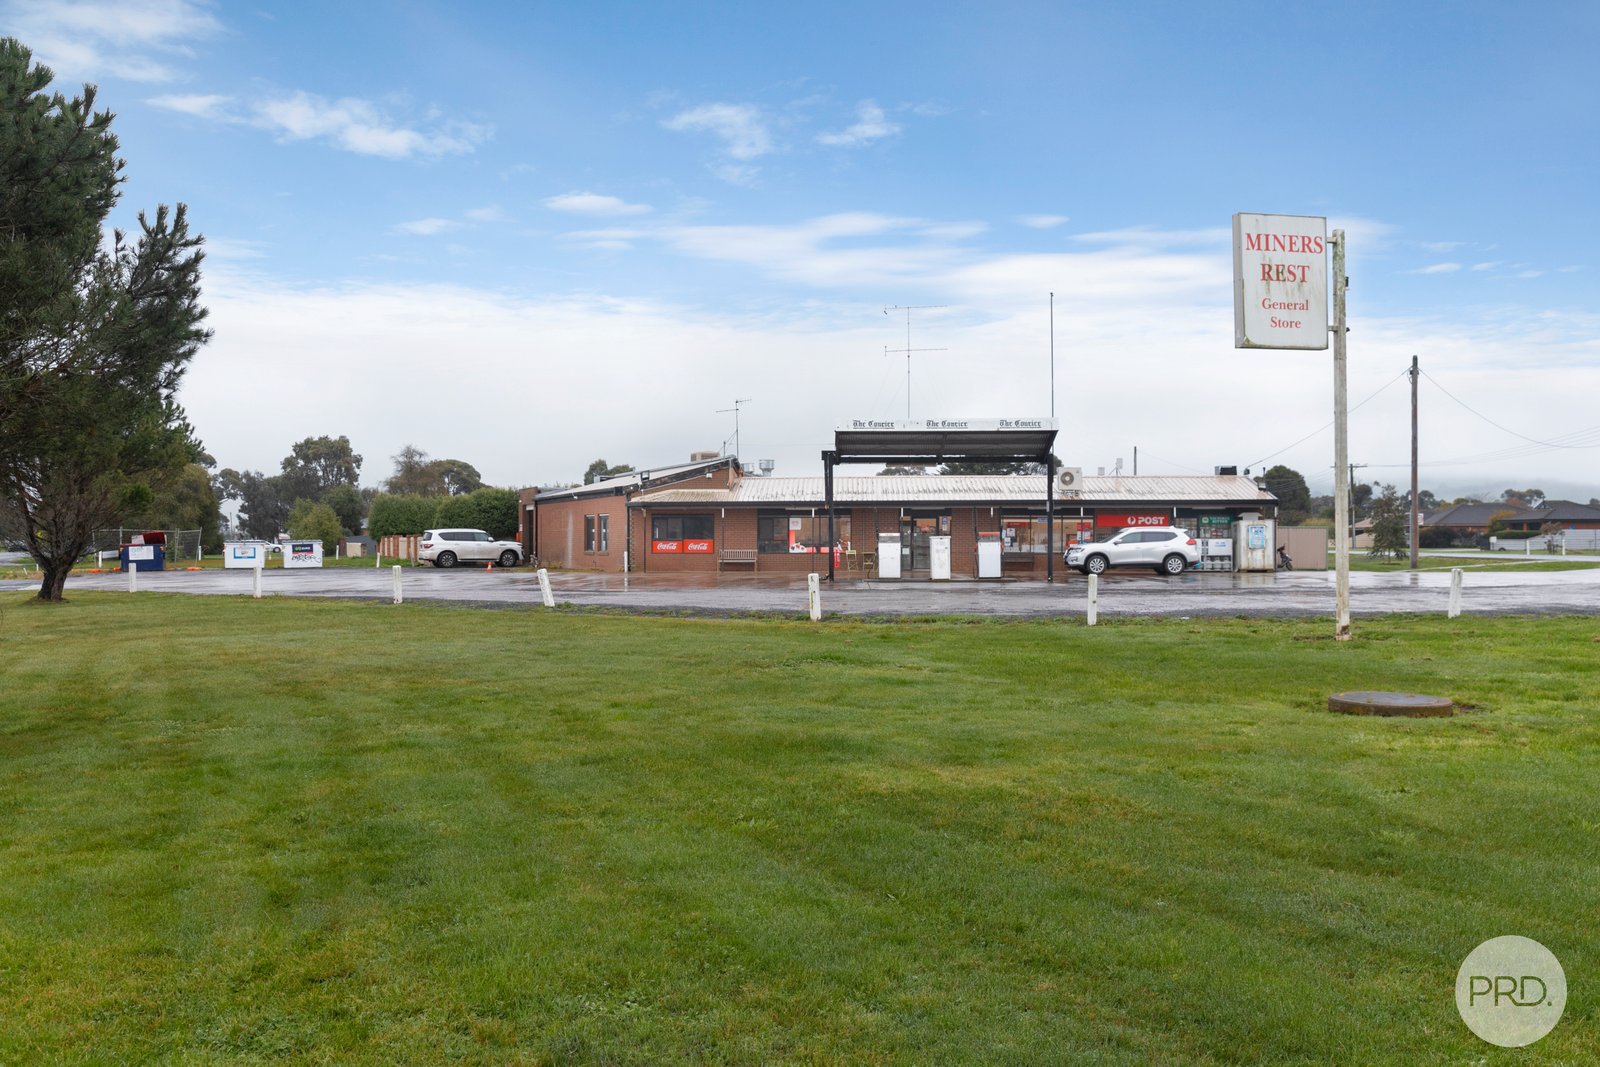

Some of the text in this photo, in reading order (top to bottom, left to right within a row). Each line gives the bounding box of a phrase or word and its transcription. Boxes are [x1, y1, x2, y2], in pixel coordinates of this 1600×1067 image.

[1245, 233, 1324, 254] MINERS
[1260, 263, 1310, 283] REST
[1261, 297, 1309, 311] General
[1270, 316, 1302, 329] Store
[853, 419, 895, 428] The Courier
[926, 419, 968, 428] The Courier
[999, 419, 1041, 428] The Courier
[1138, 516, 1165, 525] POST
